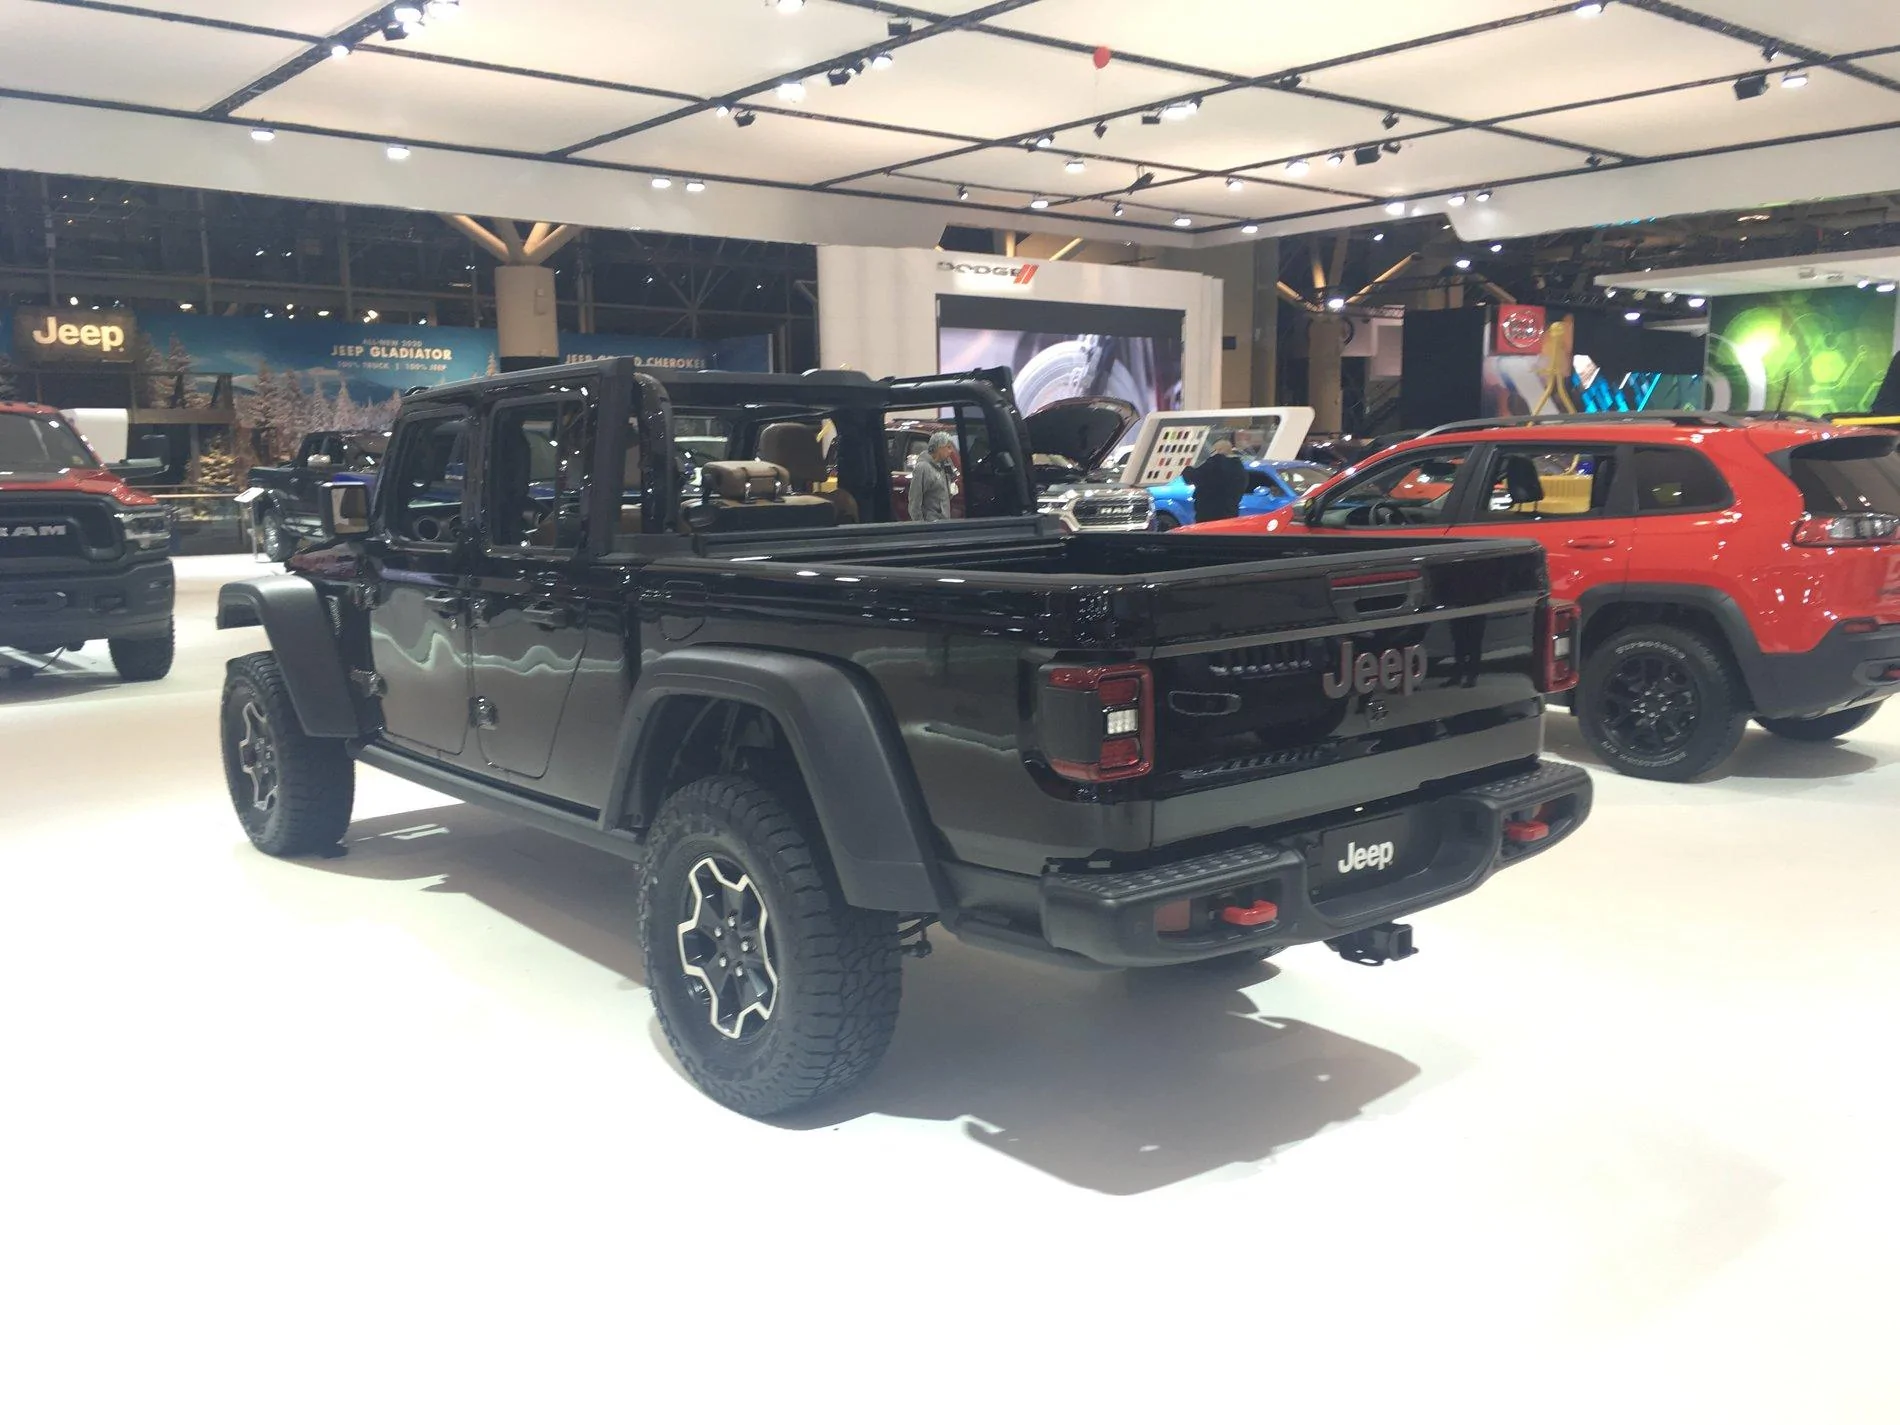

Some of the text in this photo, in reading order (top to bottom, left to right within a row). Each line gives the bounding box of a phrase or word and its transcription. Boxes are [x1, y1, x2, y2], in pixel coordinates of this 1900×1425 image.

[937, 261, 1021, 277] DODGE
[32, 316, 125, 352] Jeep
[331, 345, 453, 360] JEEP GLADIATOR
[648, 357, 707, 368] CHEROKEE
[1322, 641, 1428, 699] Jeep
[1338, 841, 1395, 873] Jeep
